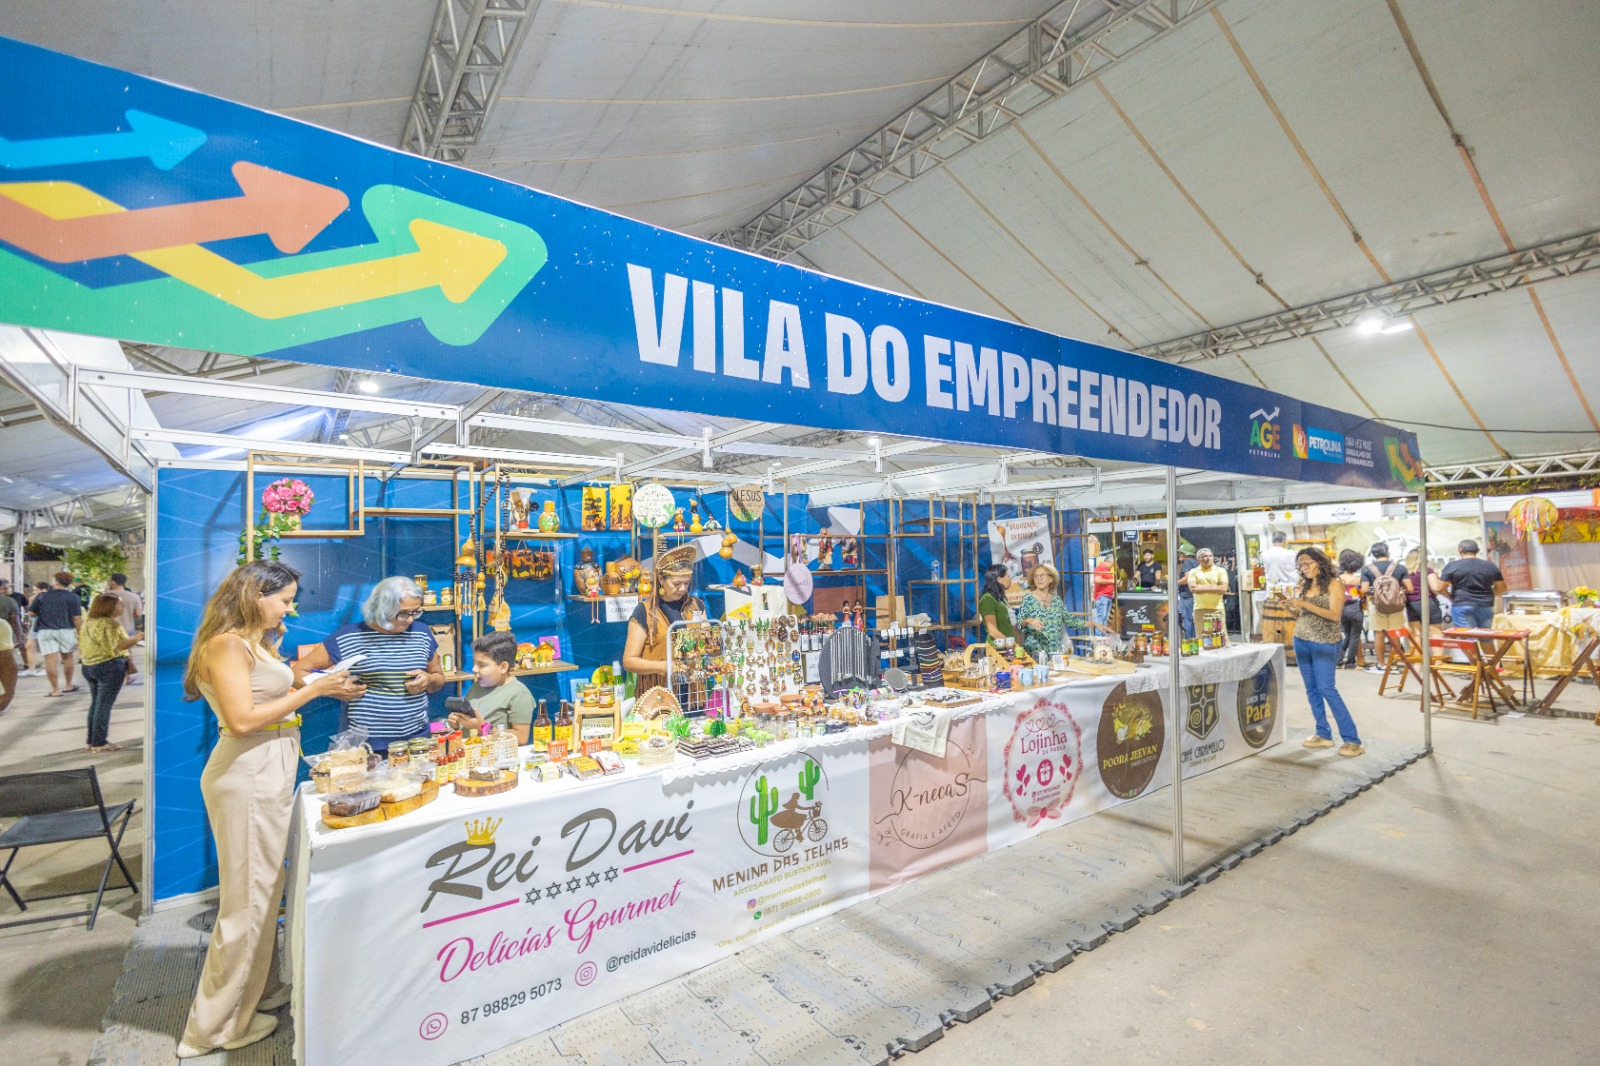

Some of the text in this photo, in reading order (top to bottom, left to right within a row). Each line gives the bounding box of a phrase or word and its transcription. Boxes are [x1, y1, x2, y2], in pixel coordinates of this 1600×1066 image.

[626, 262, 1222, 450] VILA DO EMPREENDEDOR
[1249, 419, 1281, 451] AGE
[1308, 436, 1342, 455] PETROLINA
[1248, 449, 1281, 459] PETROLINA
[1345, 448, 1366, 459] ORGULHO
[1345, 456, 1374, 468] PERNAMBUCO
[734, 489, 762, 503] JESUS
[1245, 696, 1272, 725] Pará
[1259, 693, 1266, 701] DO
[1020, 730, 1068, 755] Lojinha
[1102, 744, 1158, 770] POORA JEEVAN
[1194, 738, 1225, 759] CARAMELLO
[900, 828, 929, 841] GRAFIA
[938, 810, 962, 837] AFETO
[420, 800, 695, 914] Rei Davi
[712, 836, 849, 894] MENINA DAS TELHAS
[732, 857, 833, 898] ARTESANATO SUSTENTÁVEL
[756, 873, 828, 907] @meninadastelhas
[763, 904, 779, 917] (87)
[436, 878, 686, 984] Delícias Gourmet
[605, 929, 697, 973] @reidavidelicias
[460, 977, 563, 1025] 87 98829 5073
